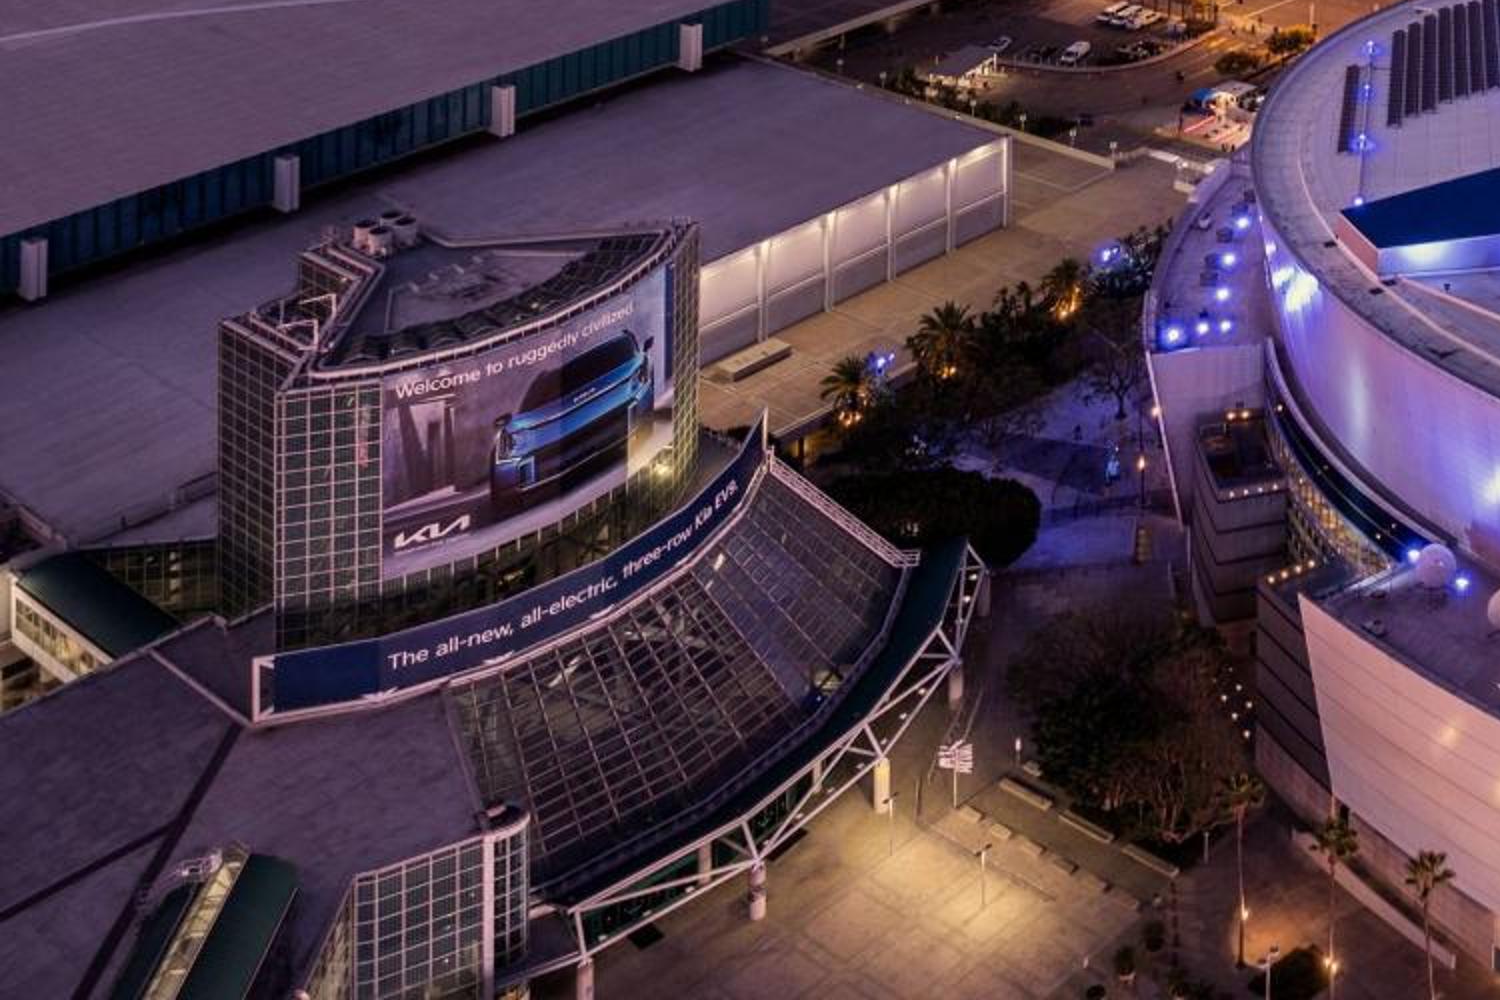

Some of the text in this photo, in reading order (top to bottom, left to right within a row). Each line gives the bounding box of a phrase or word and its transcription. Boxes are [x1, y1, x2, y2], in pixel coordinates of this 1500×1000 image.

[395, 370, 481, 399] Welcome
[486, 361, 503, 377] to
[508, 329, 578, 368] ruggedly
[388, 651, 429, 671] The
[435, 622, 515, 656] all-new,
[520, 576, 618, 627] all-electric,
[623, 524, 693, 578] three-row
[694, 505, 714, 531] Kia
